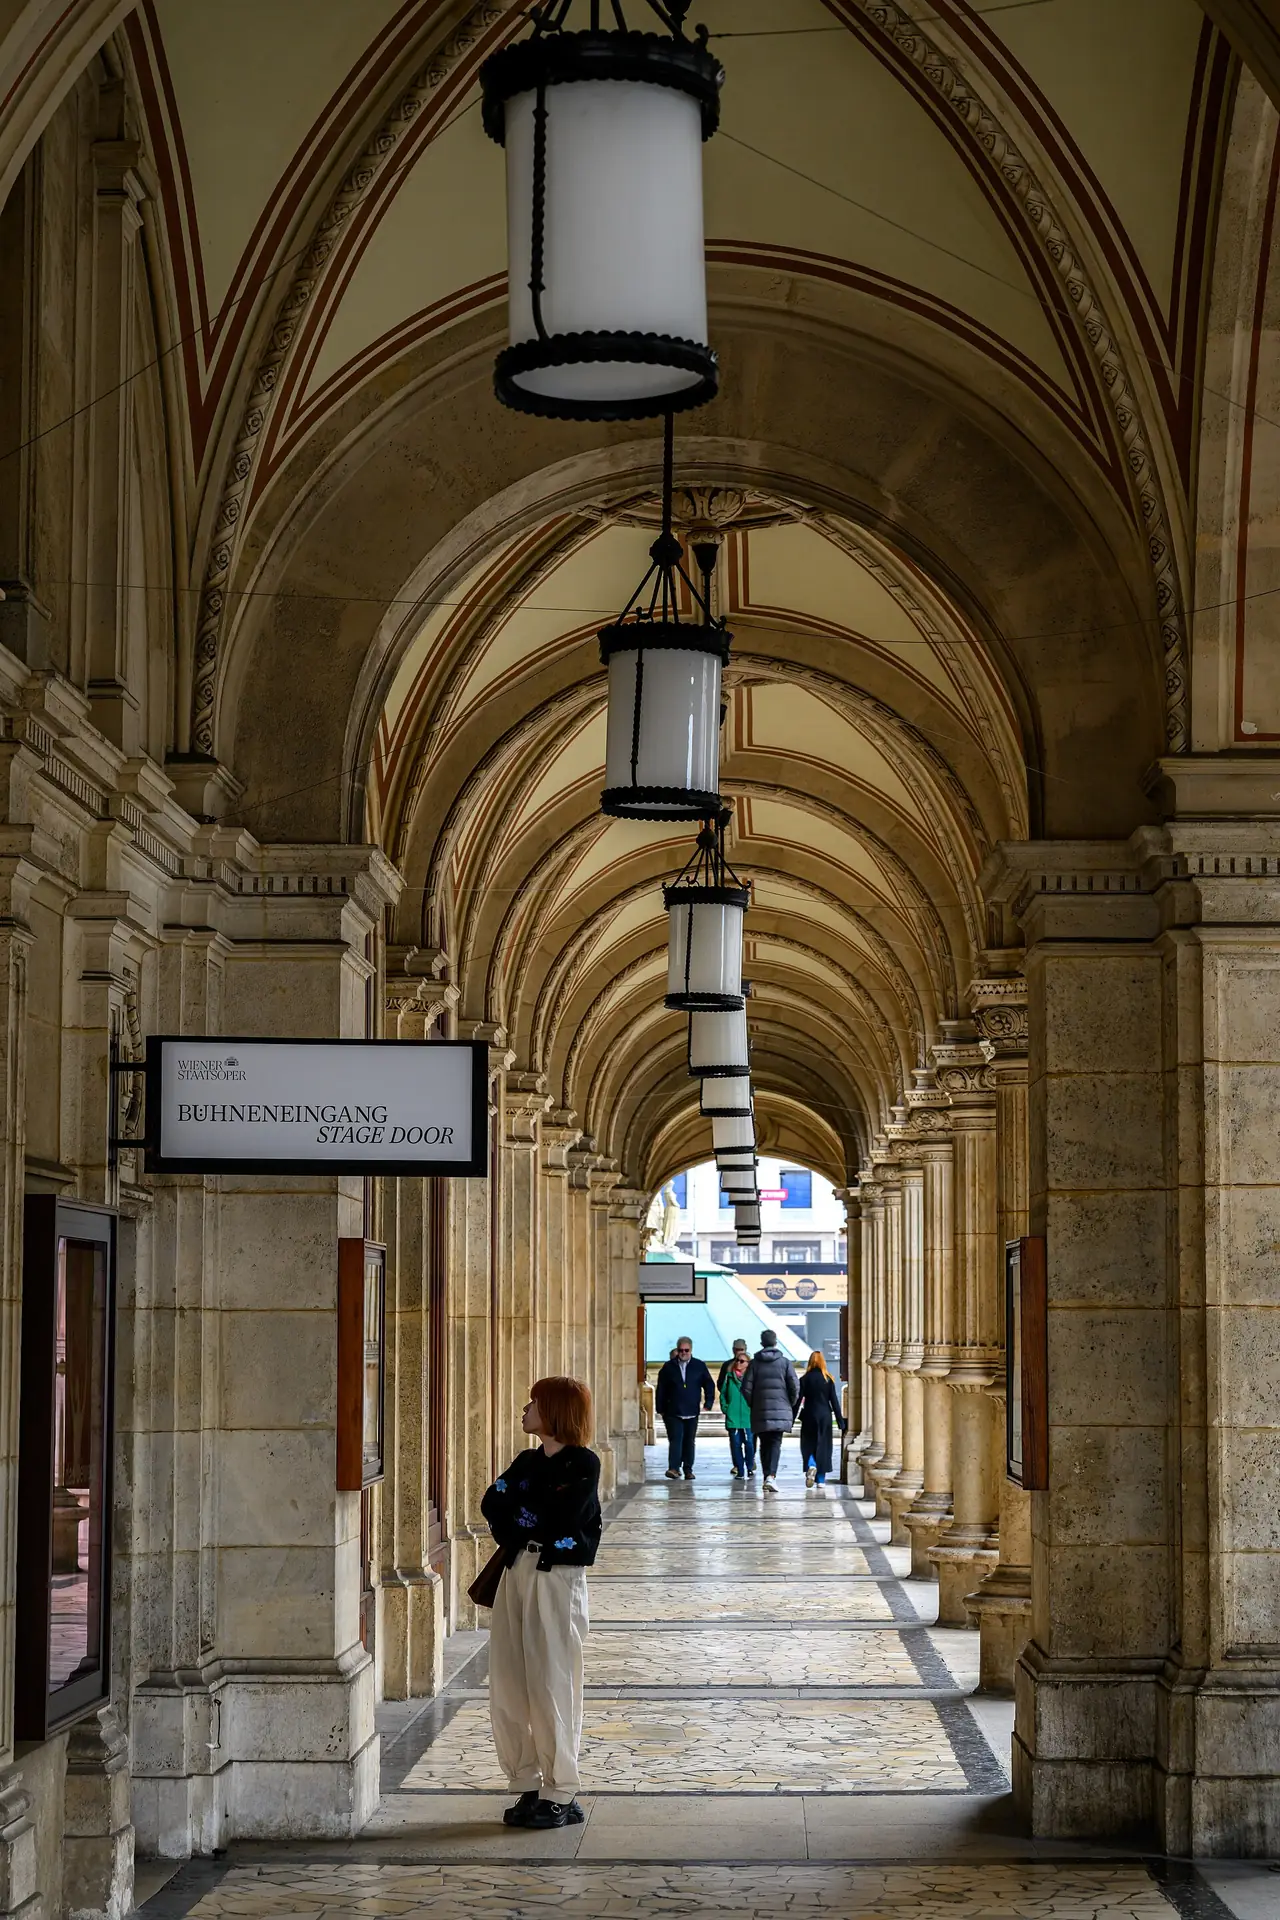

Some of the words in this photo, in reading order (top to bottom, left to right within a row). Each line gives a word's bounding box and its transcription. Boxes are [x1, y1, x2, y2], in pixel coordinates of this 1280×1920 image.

[177, 1060, 223, 1070] WIENER
[177, 1070, 247, 1081] STAATSOPER
[177, 1104, 388, 1124] BÜHNENEINGANG
[316, 1126, 385, 1144] STAGE
[388, 1126, 454, 1145] DOOR
